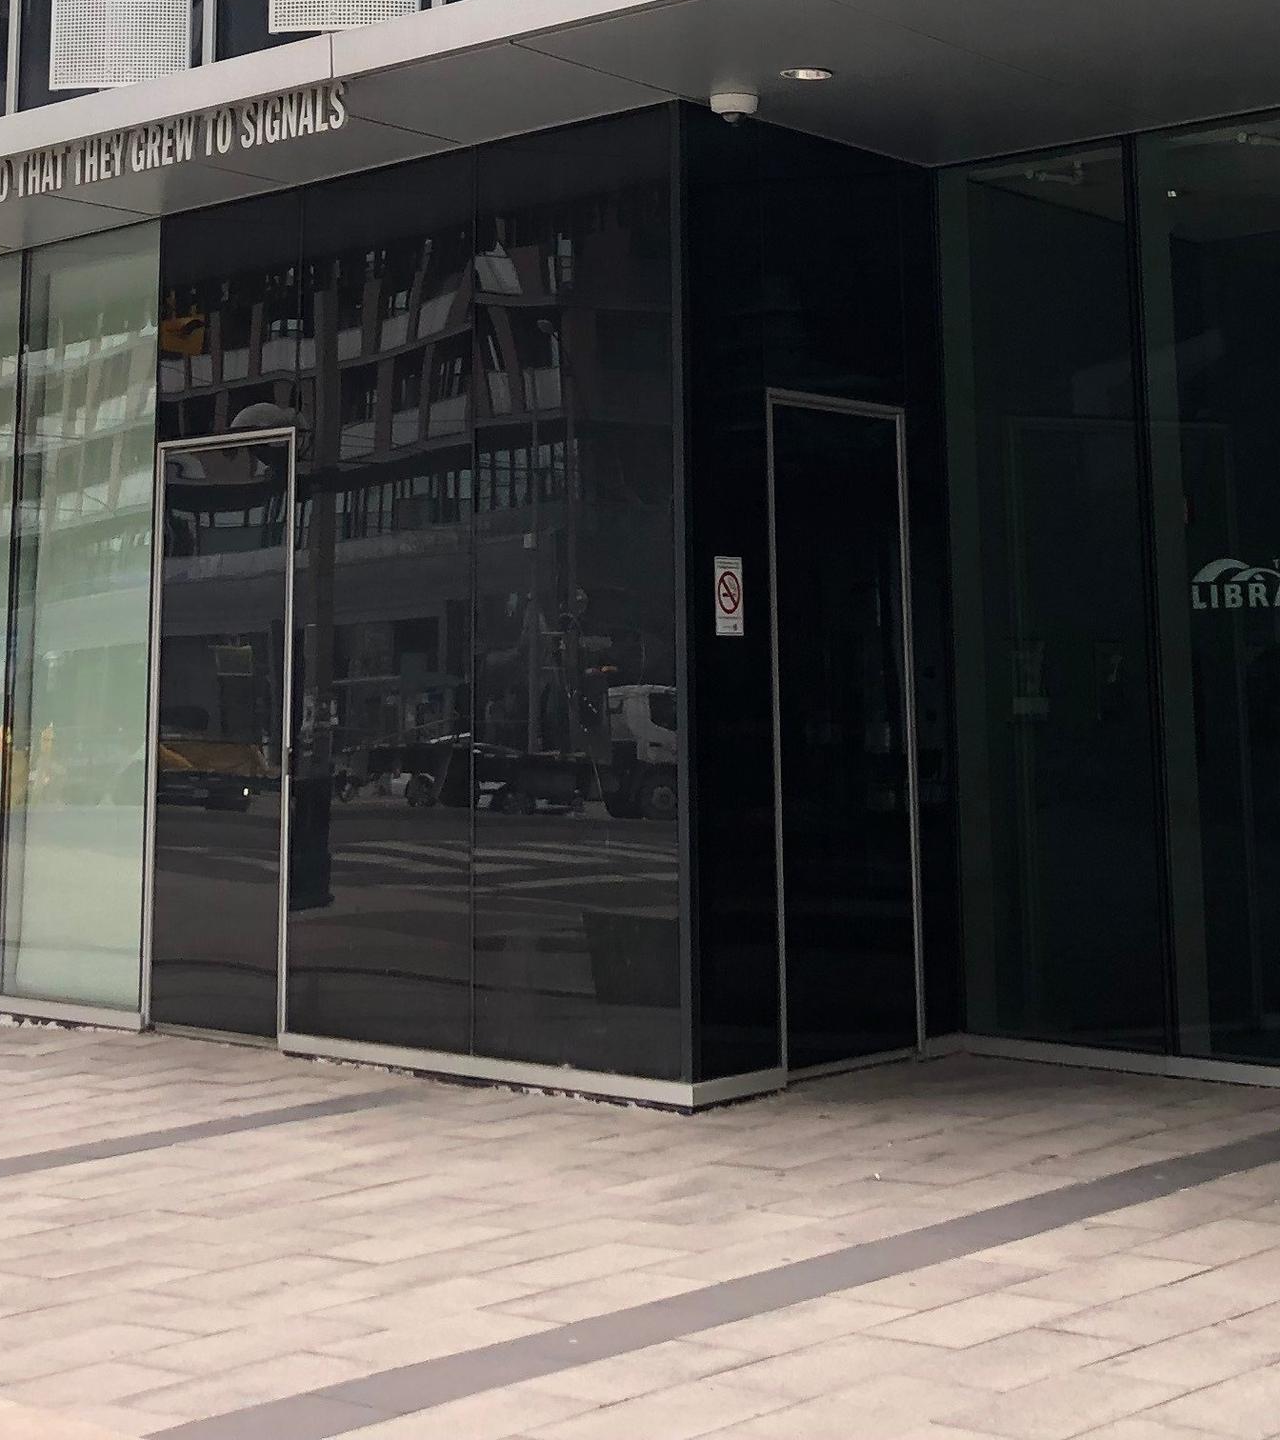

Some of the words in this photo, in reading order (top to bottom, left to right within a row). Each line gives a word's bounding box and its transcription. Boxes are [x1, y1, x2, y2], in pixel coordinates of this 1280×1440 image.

[18, 149, 65, 198] THAT
[74, 133, 124, 185] THEY
[131, 116, 195, 173] GREW
[204, 107, 233, 157] TO
[240, 80, 346, 150] SIGNALS
